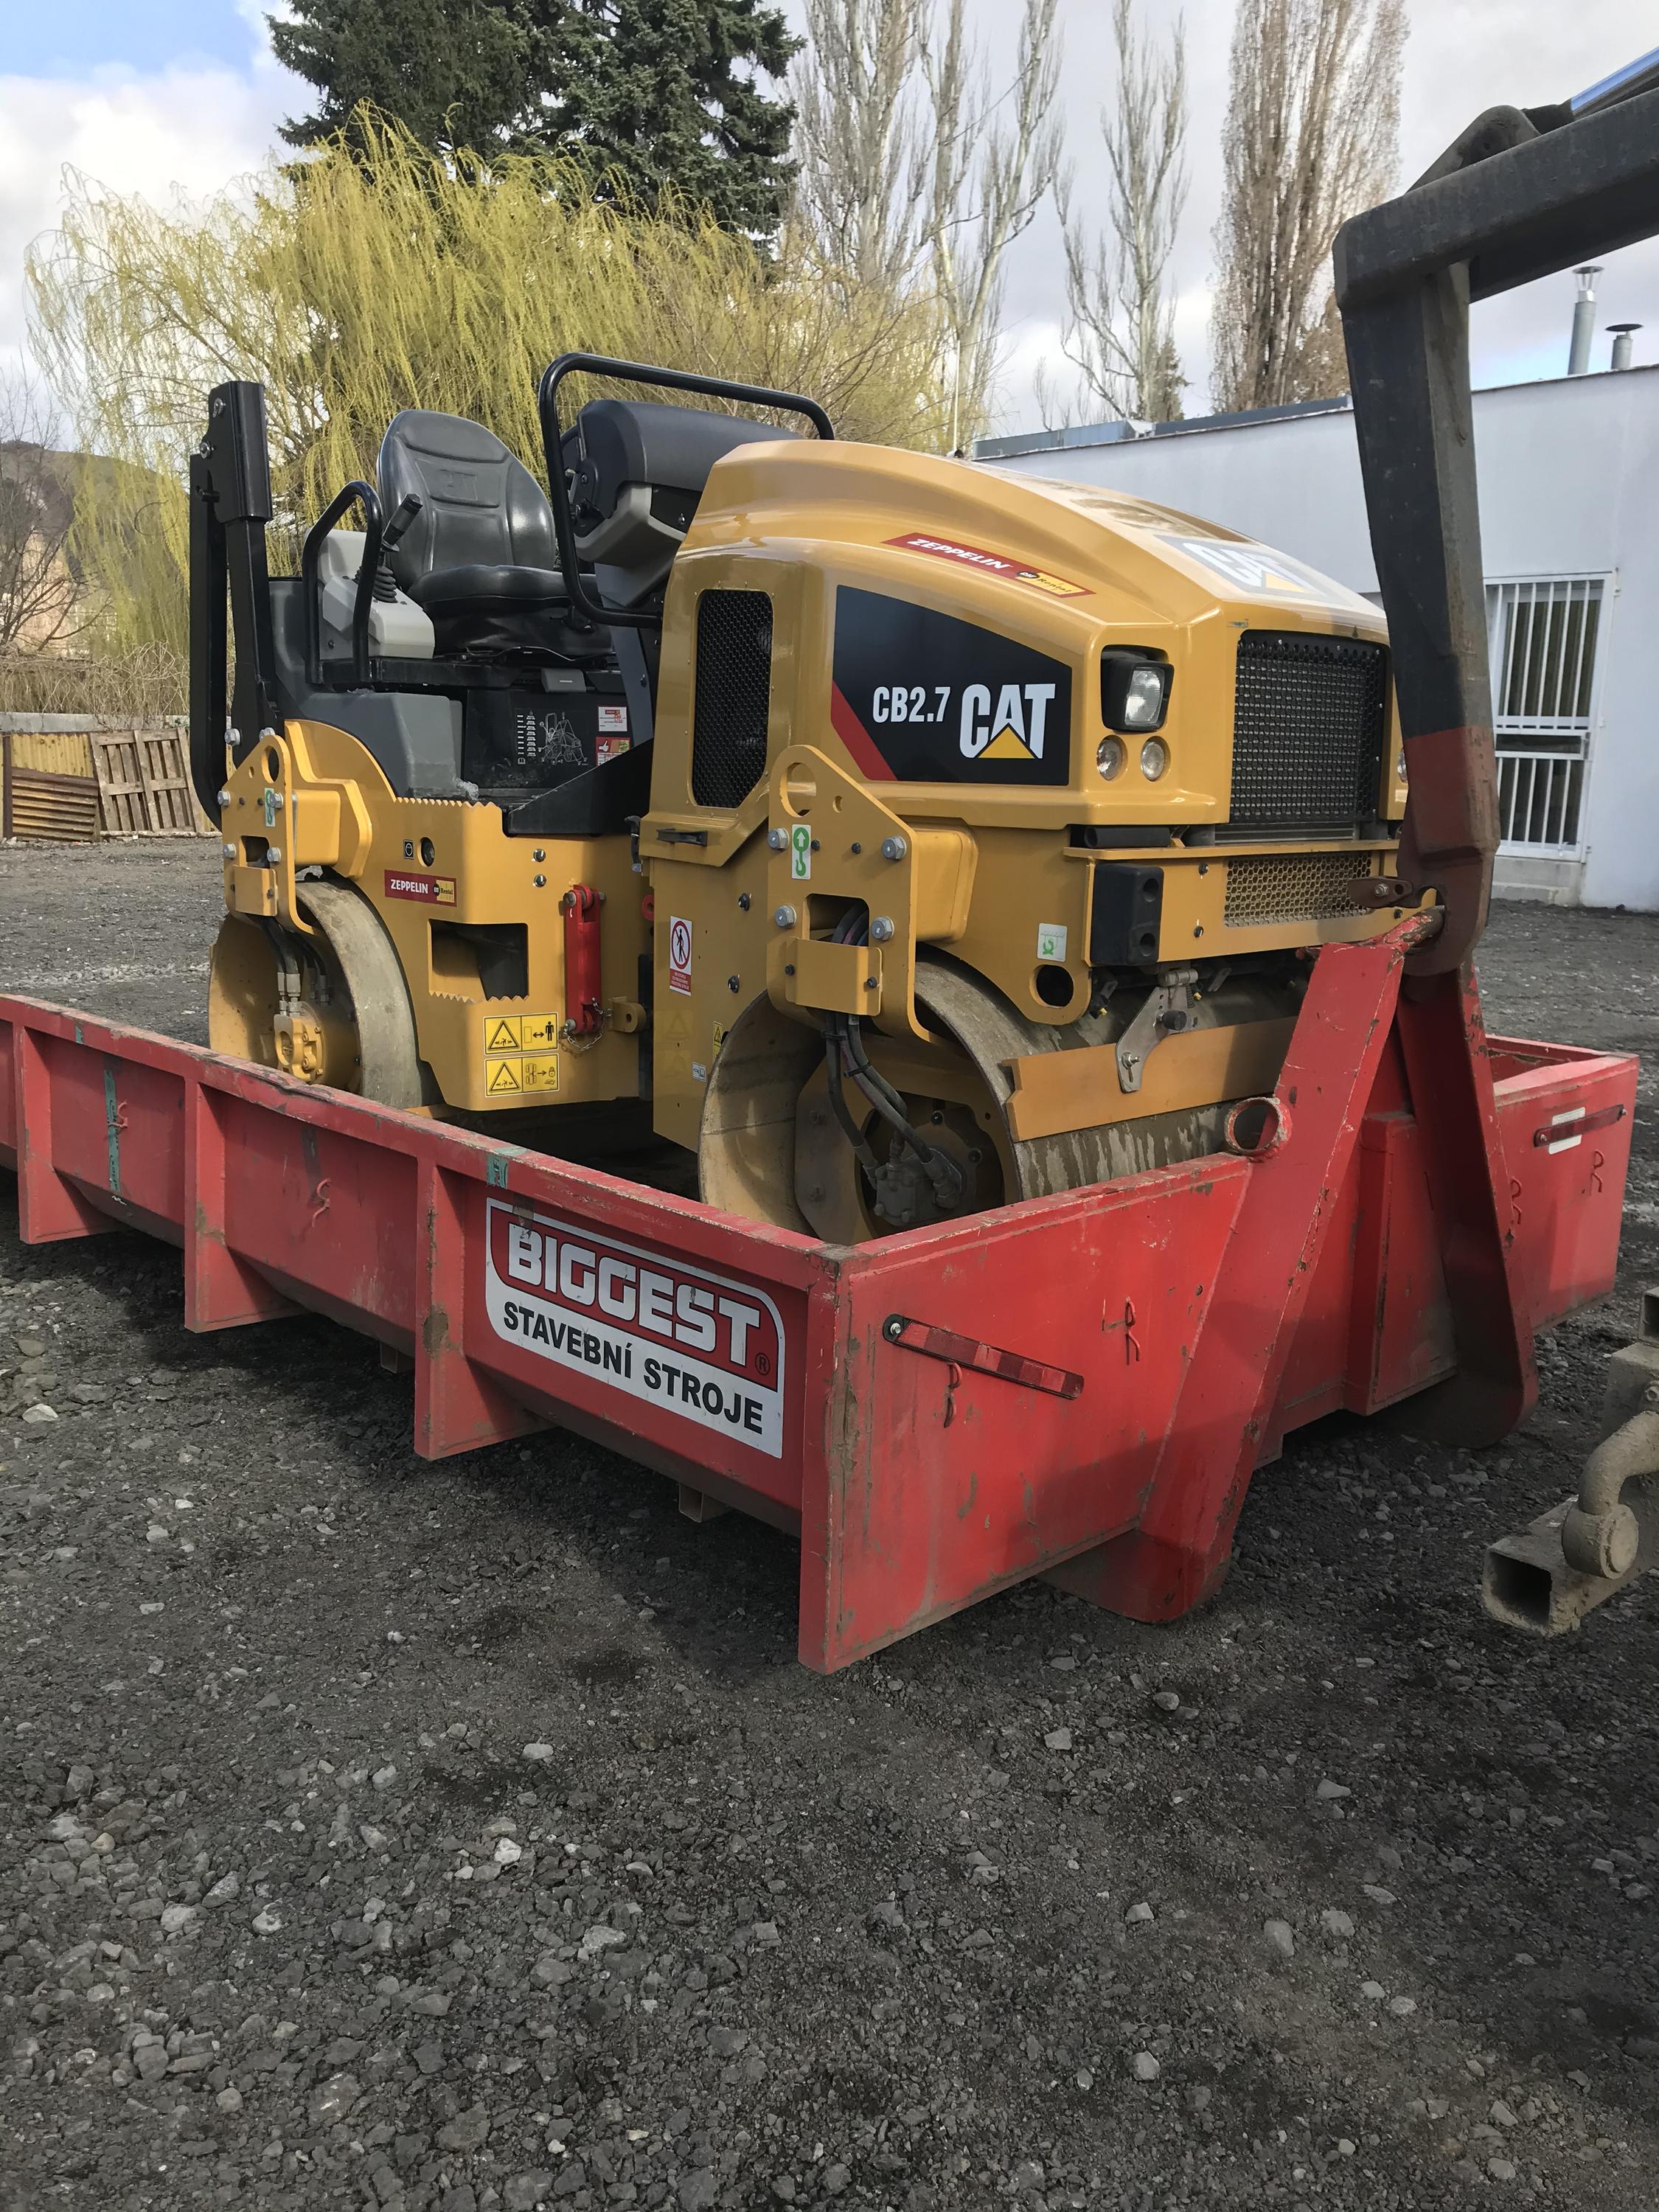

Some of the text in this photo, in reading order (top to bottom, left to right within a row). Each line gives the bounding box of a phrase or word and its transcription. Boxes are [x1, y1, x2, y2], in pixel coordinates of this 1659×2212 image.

[907, 538, 1011, 569] ZEPPELIN
[1182, 542, 1327, 596] CAT
[872, 684, 1056, 759] CB2.7 CAT
[390, 879, 428, 894] ZEPPELIN
[508, 1222, 760, 1367] BIGGEST
[504, 1301, 763, 1435] STAVEBNÍ STROJE
